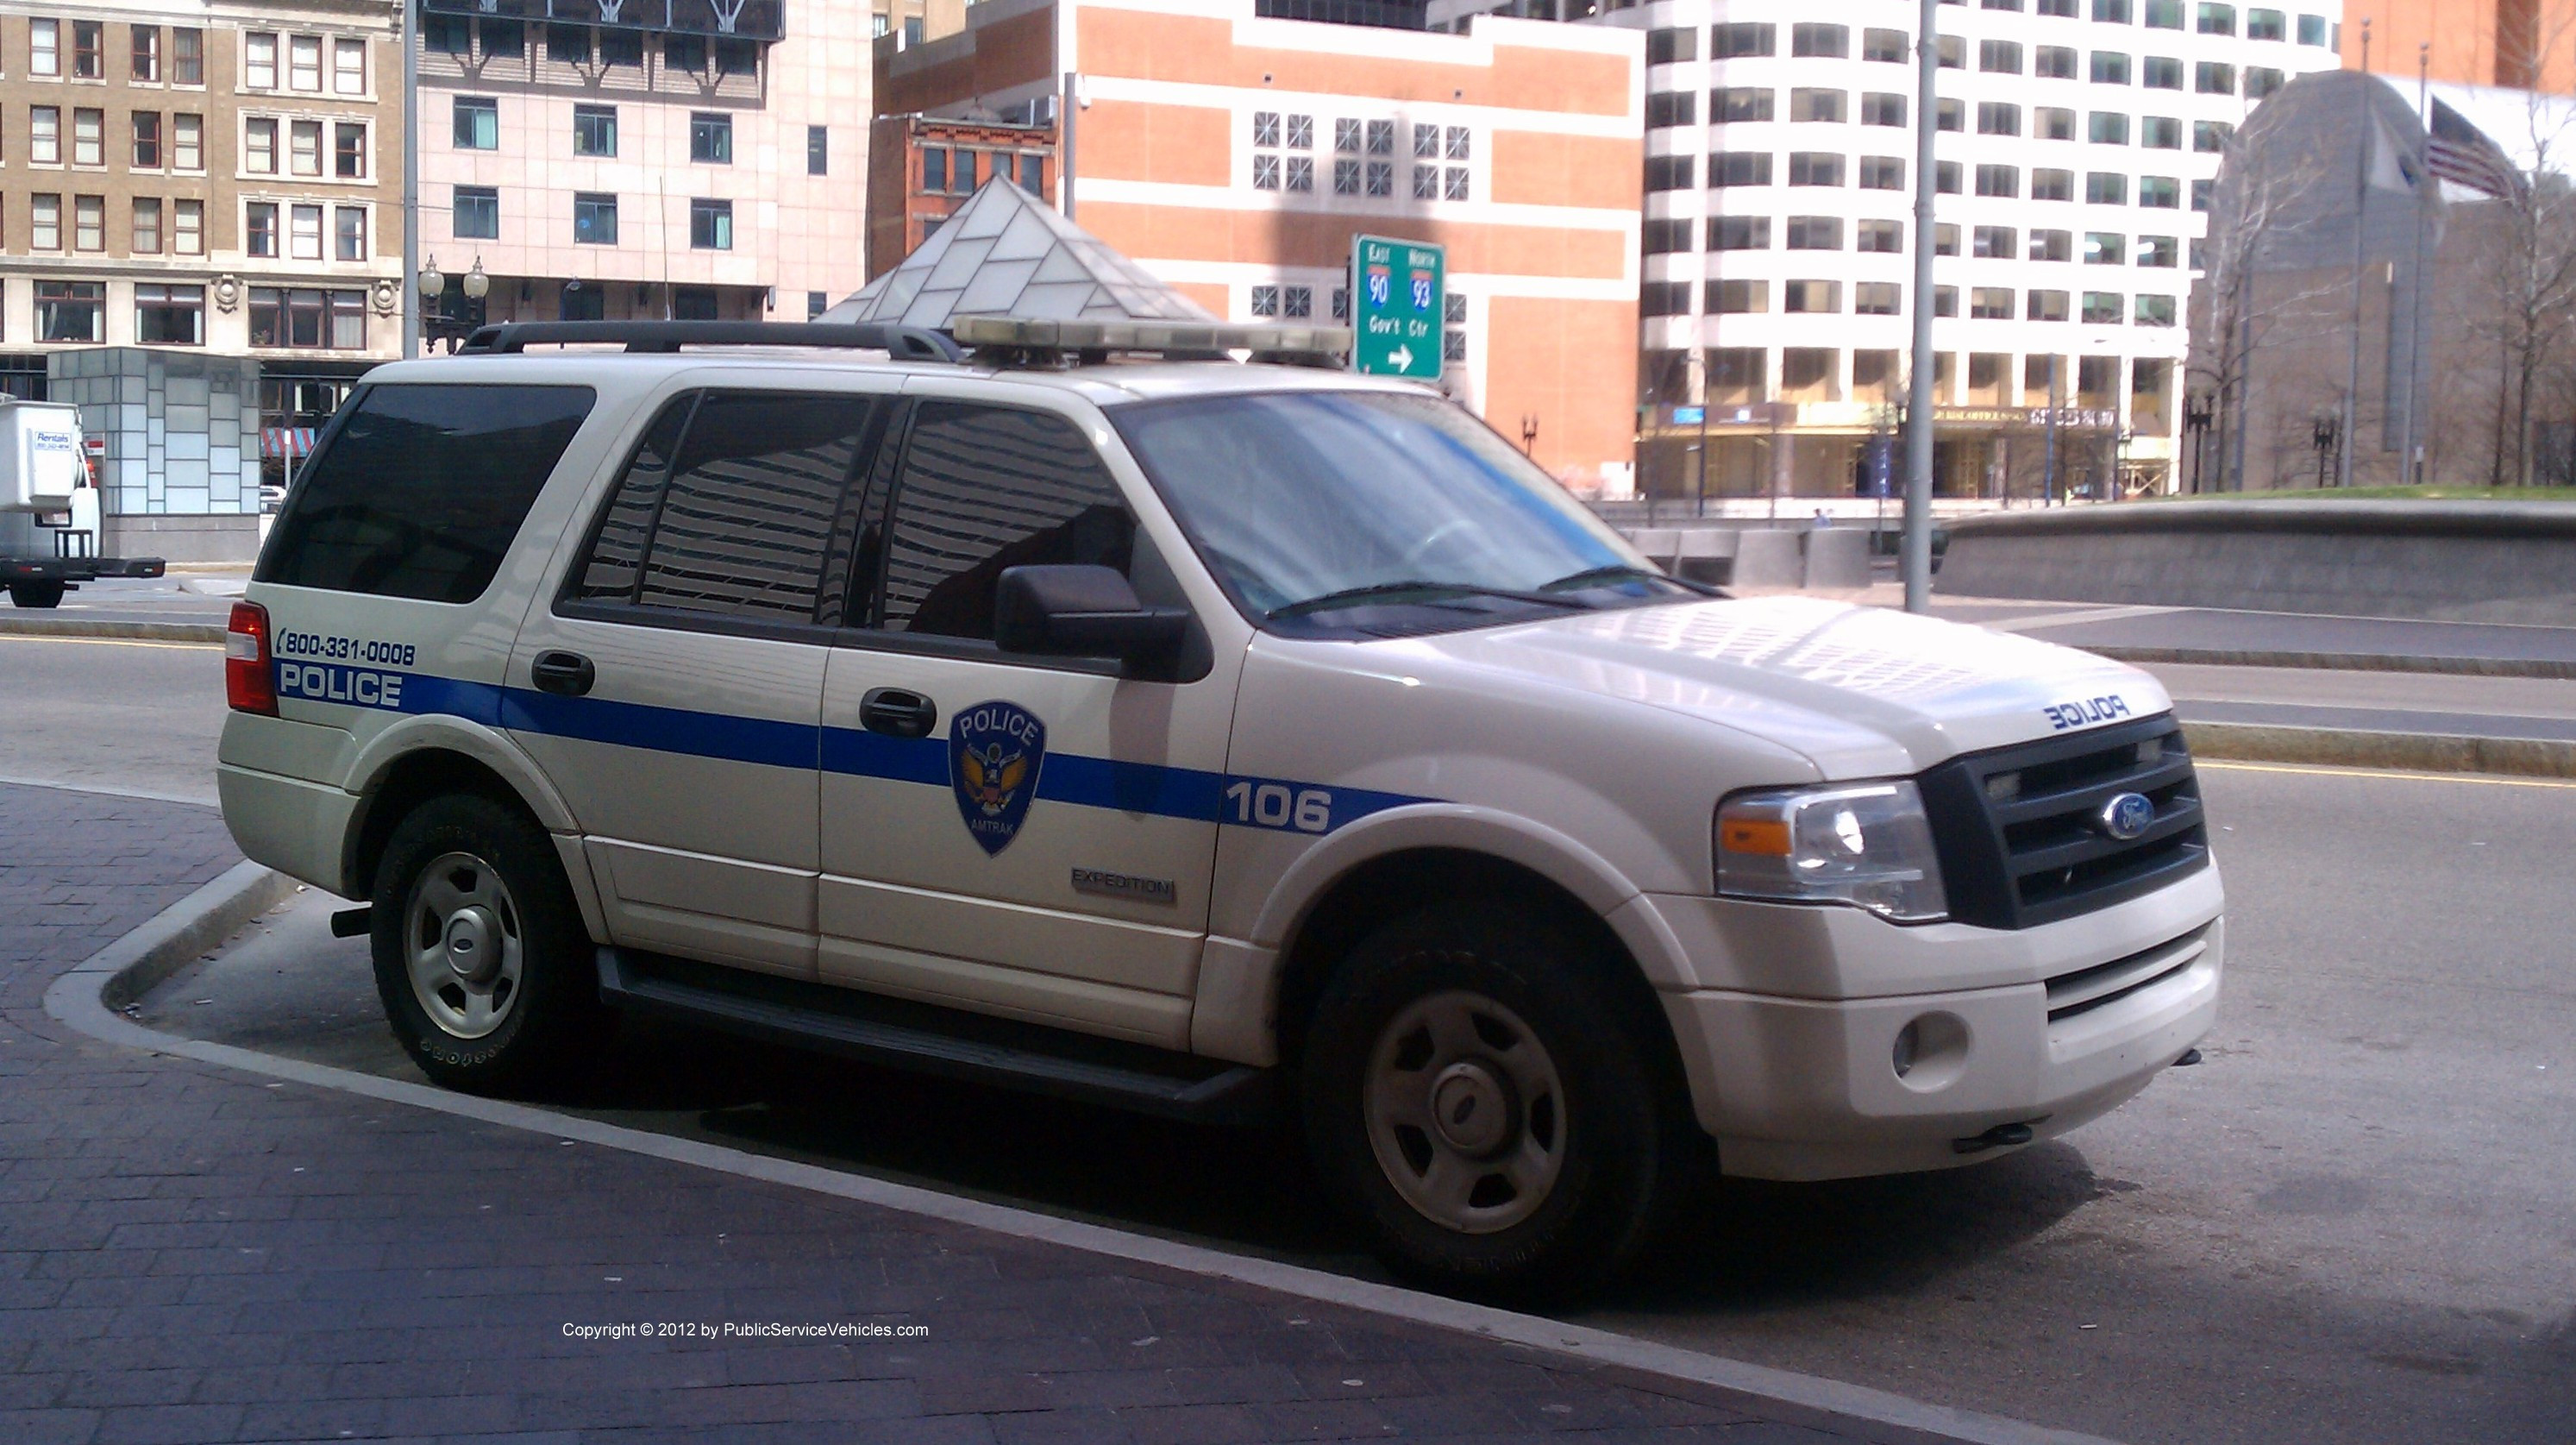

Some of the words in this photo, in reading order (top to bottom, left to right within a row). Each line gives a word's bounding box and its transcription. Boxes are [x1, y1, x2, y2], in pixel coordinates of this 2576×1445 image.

[1369, 275, 1388, 304] 90
[1413, 280, 1431, 308] 93
[1369, 314, 1401, 335] Gov't
[1408, 319, 1429, 337] Ctr
[37, 432, 69, 443] Rentals
[286, 632, 416, 666] 800-331-0008
[280, 663, 402, 707] POLICE
[959, 708, 1038, 746] POLICE
[1226, 781, 1332, 832] 106
[971, 819, 1013, 834] AMTRAK
[1072, 869, 1169, 894] EXPEDITION
